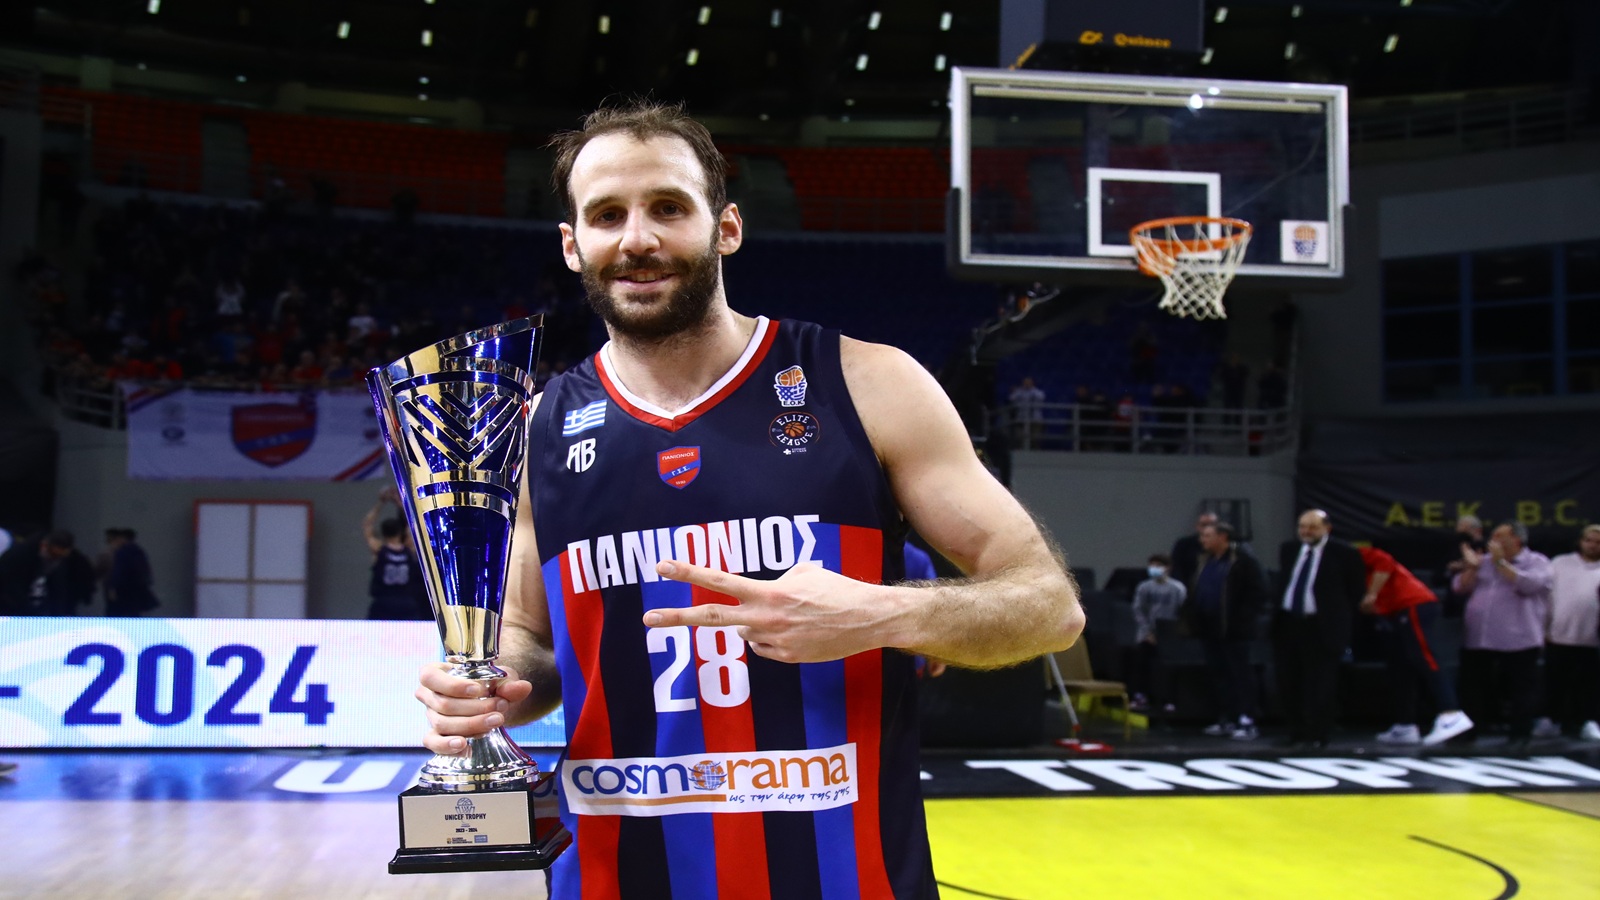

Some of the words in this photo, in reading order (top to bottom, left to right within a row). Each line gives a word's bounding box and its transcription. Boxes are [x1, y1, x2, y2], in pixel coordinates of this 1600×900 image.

[776, 414, 810, 426] ELITE
[776, 432, 813, 446] LEAGUE
[62, 642, 335, 727] 2024
[646, 625, 750, 713] 28
